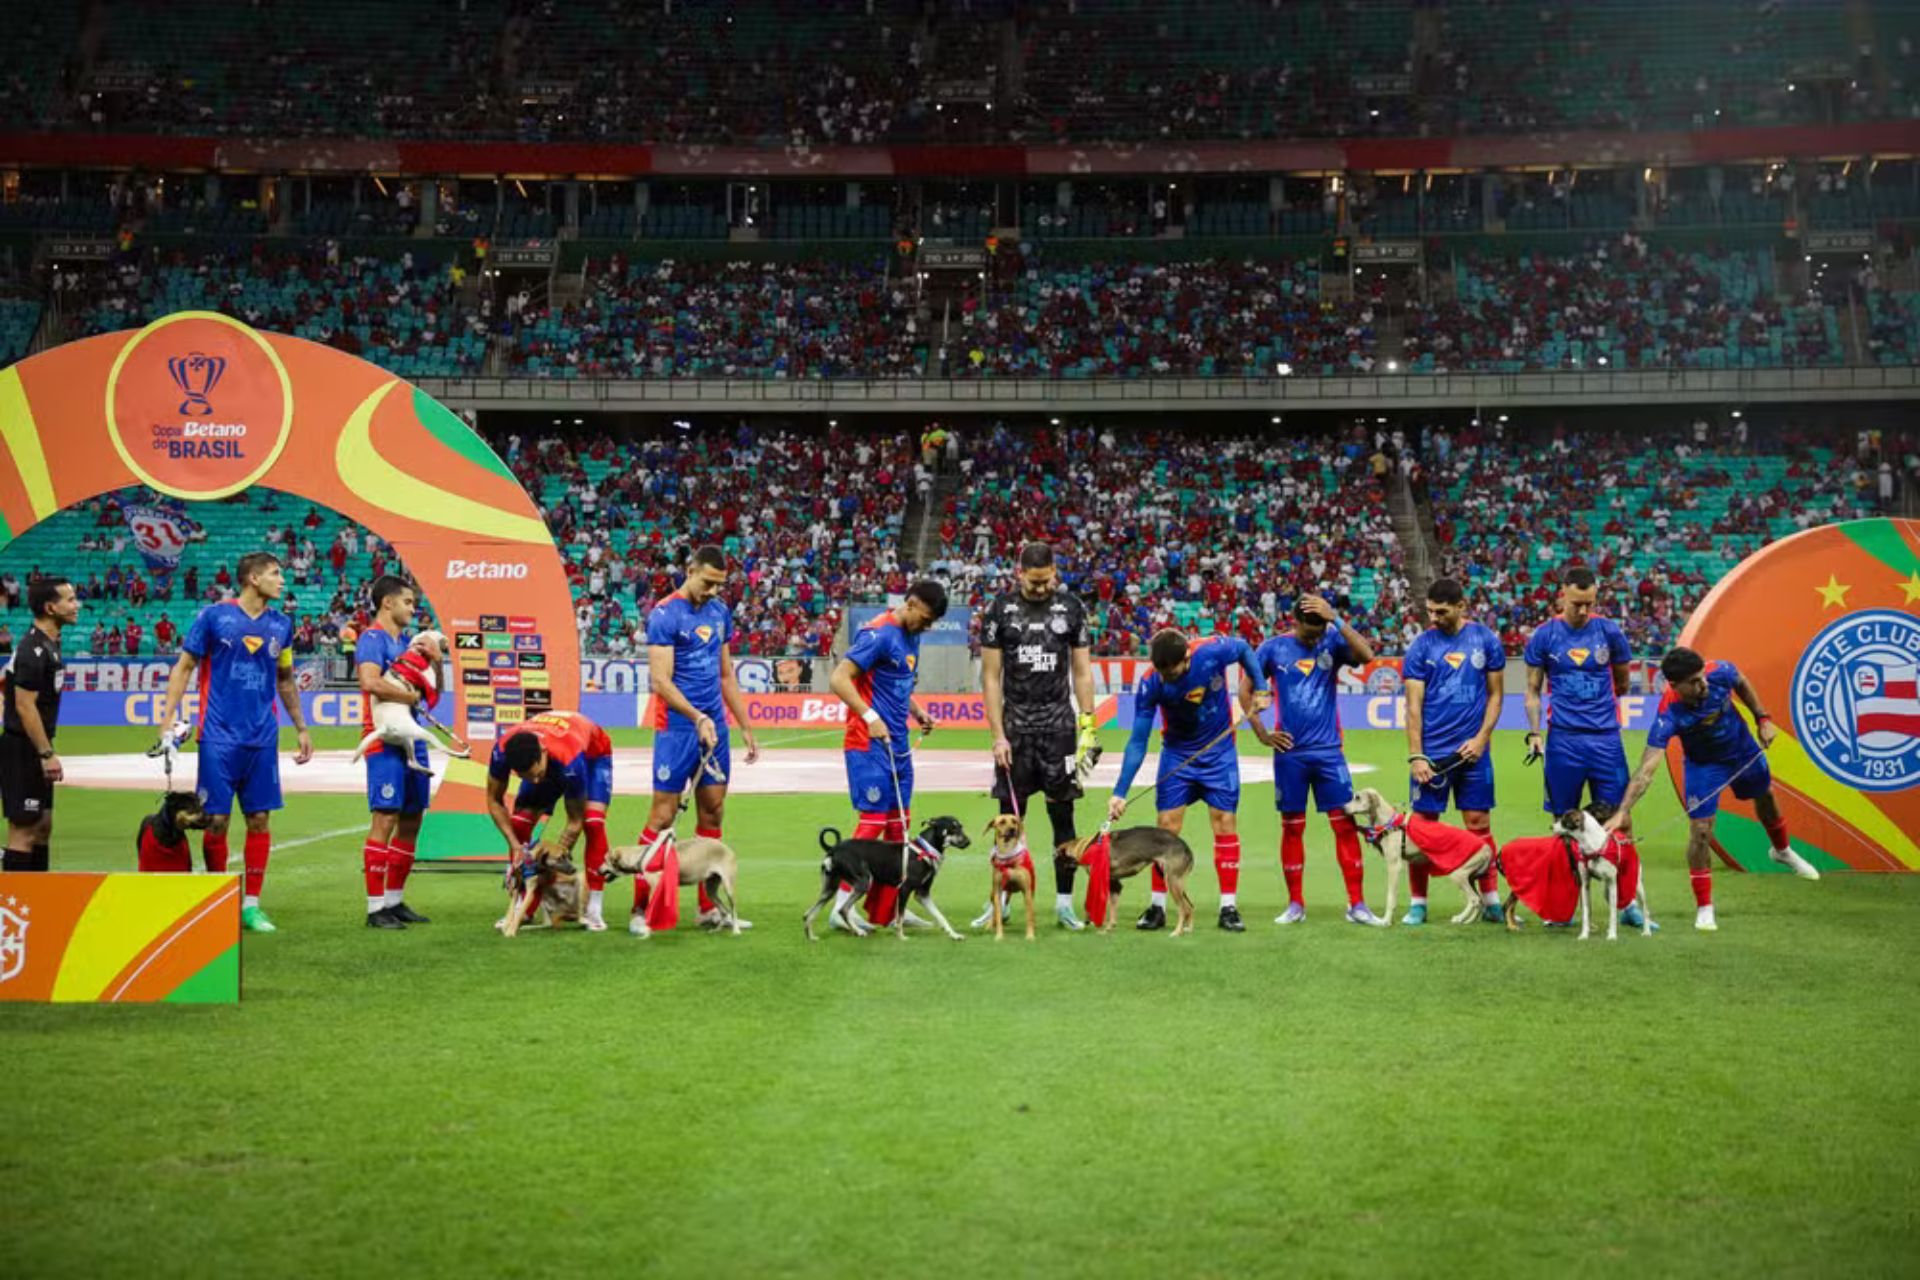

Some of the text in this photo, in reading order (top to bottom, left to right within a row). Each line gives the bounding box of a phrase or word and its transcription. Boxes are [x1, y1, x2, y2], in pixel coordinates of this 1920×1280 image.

[152, 421, 247, 439] Copa Betano
[152, 438, 245, 459] do BRASIL
[446, 560, 529, 580] Betano
[458, 635, 480, 647] 7K
[62, 662, 200, 692] TRIC
[1805, 634, 1852, 750] ESPORTE
[312, 693, 364, 726] CB
[748, 699, 984, 722] Copa Bet BRAS
[1862, 758, 1906, 778] 1931
